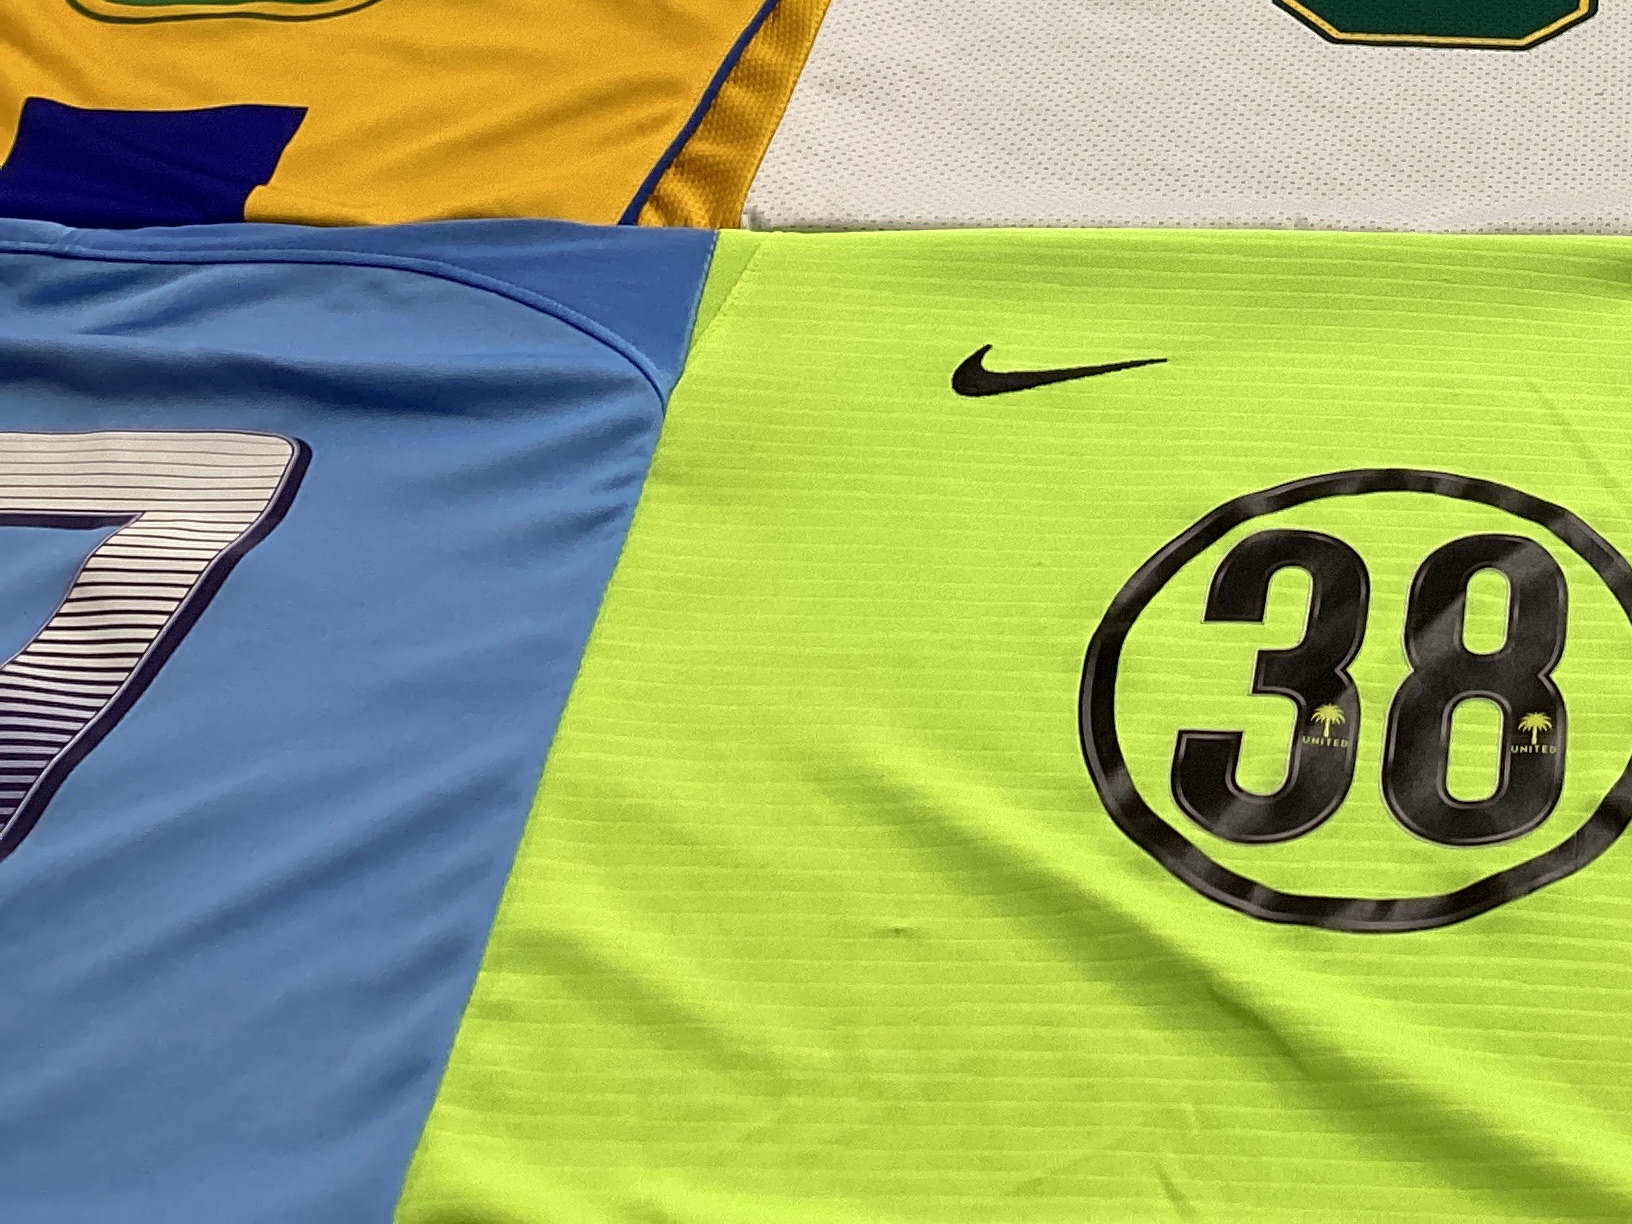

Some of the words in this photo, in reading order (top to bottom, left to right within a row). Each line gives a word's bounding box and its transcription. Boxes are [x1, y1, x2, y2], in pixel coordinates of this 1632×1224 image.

[1170, 528, 1569, 848] 38
[1302, 734, 1349, 748] UNITED
[1510, 743, 1558, 755] UNITED
